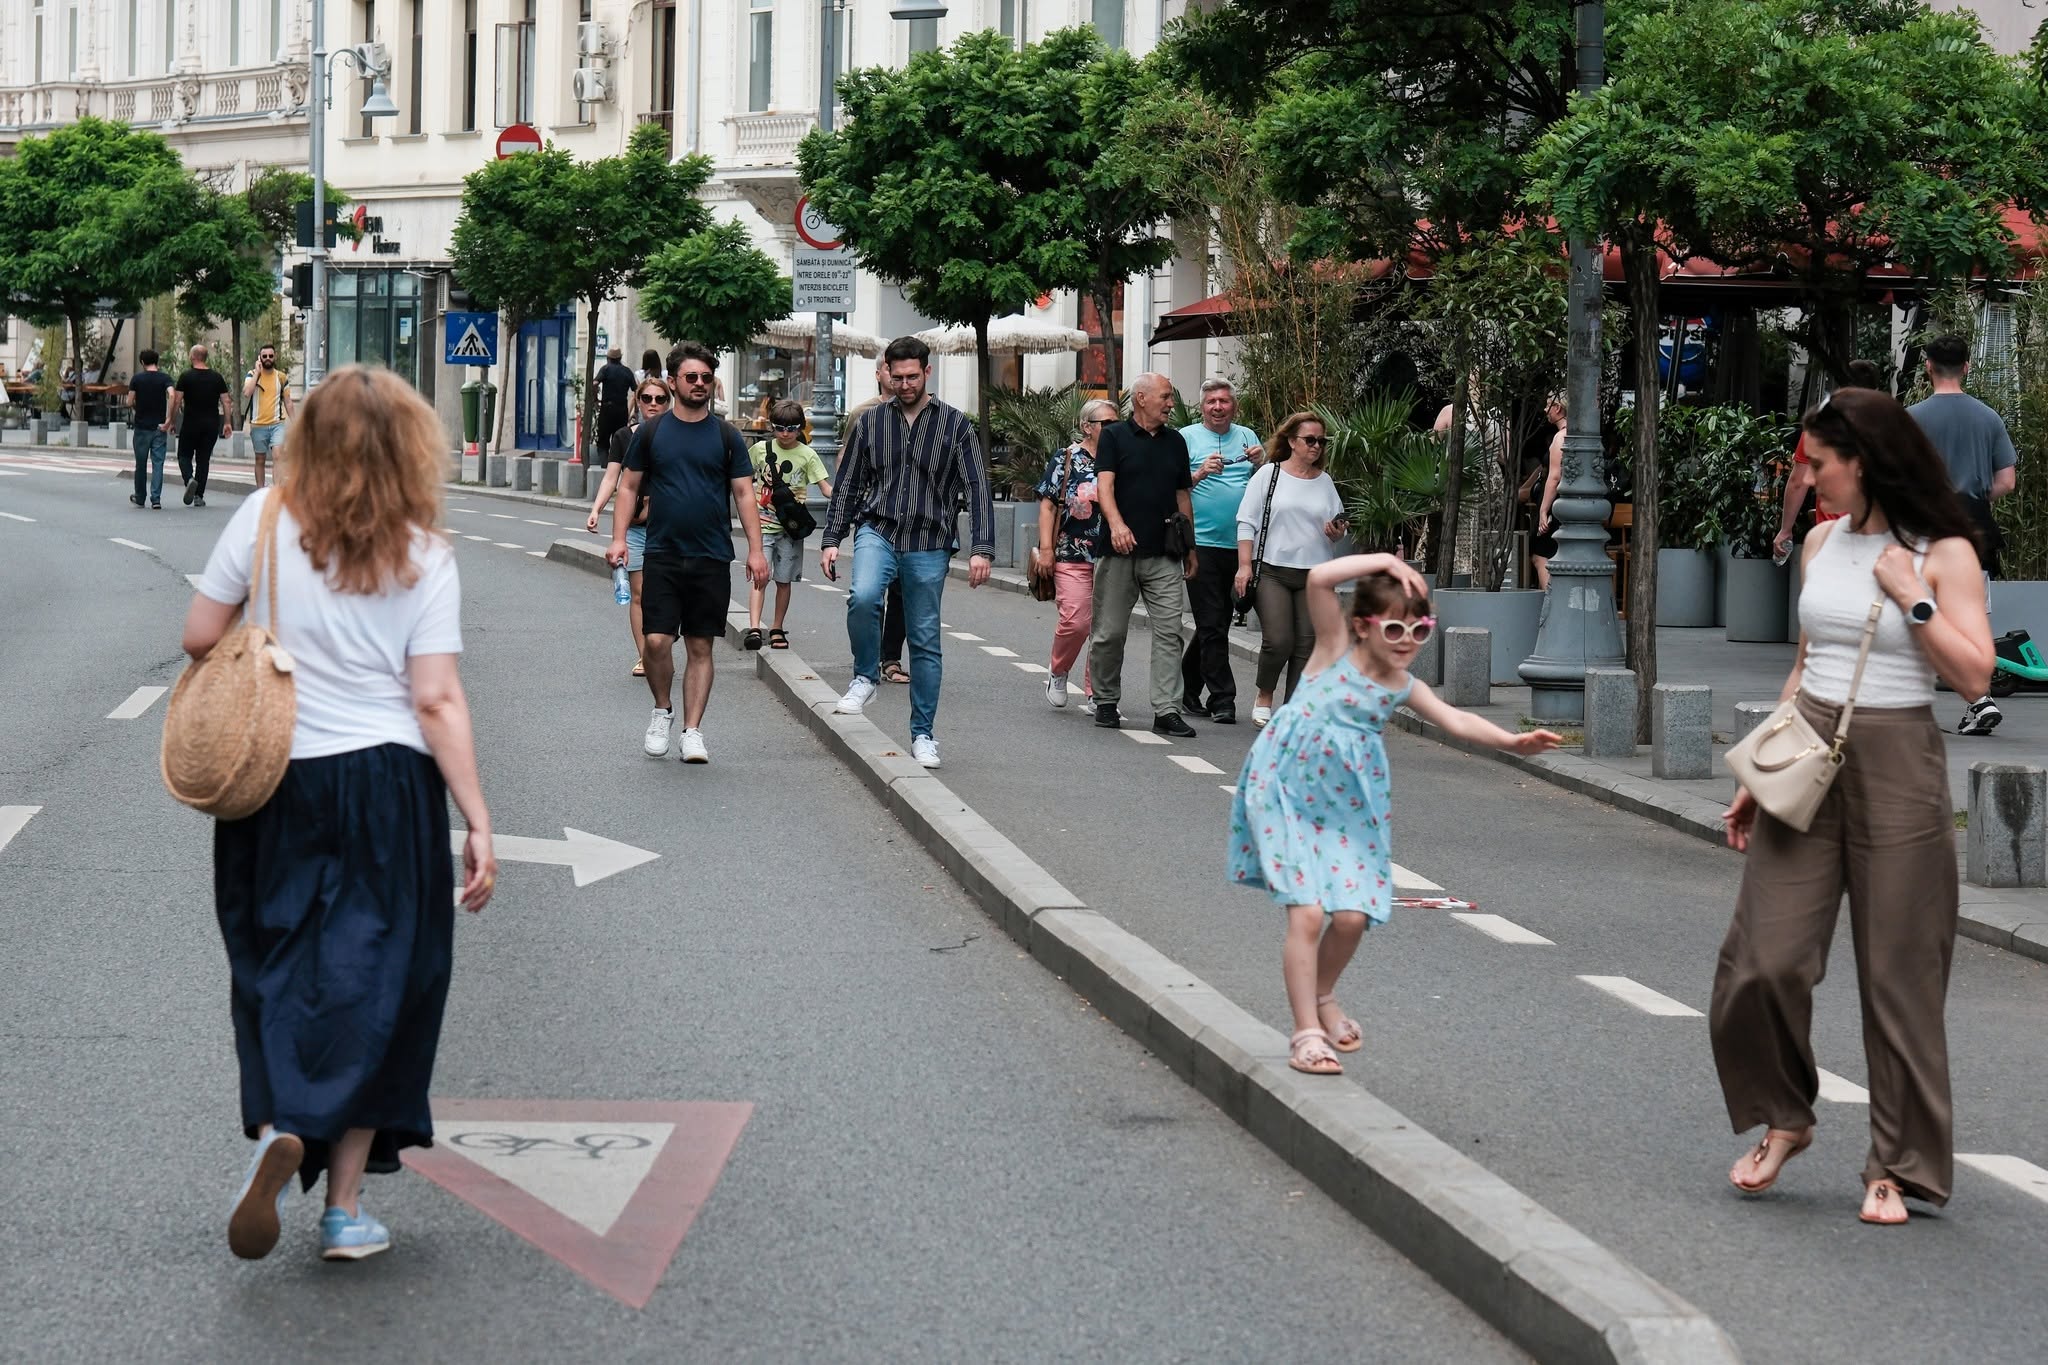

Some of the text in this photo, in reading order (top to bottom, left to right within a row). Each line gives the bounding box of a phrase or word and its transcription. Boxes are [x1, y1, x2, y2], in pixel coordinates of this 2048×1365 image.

[797, 269, 812, 279] ÎNTRE
[813, 271, 831, 279] ORELE
[799, 283, 849, 292] INTERZIS BICICLETE
[813, 295, 841, 304] TROTINETE
